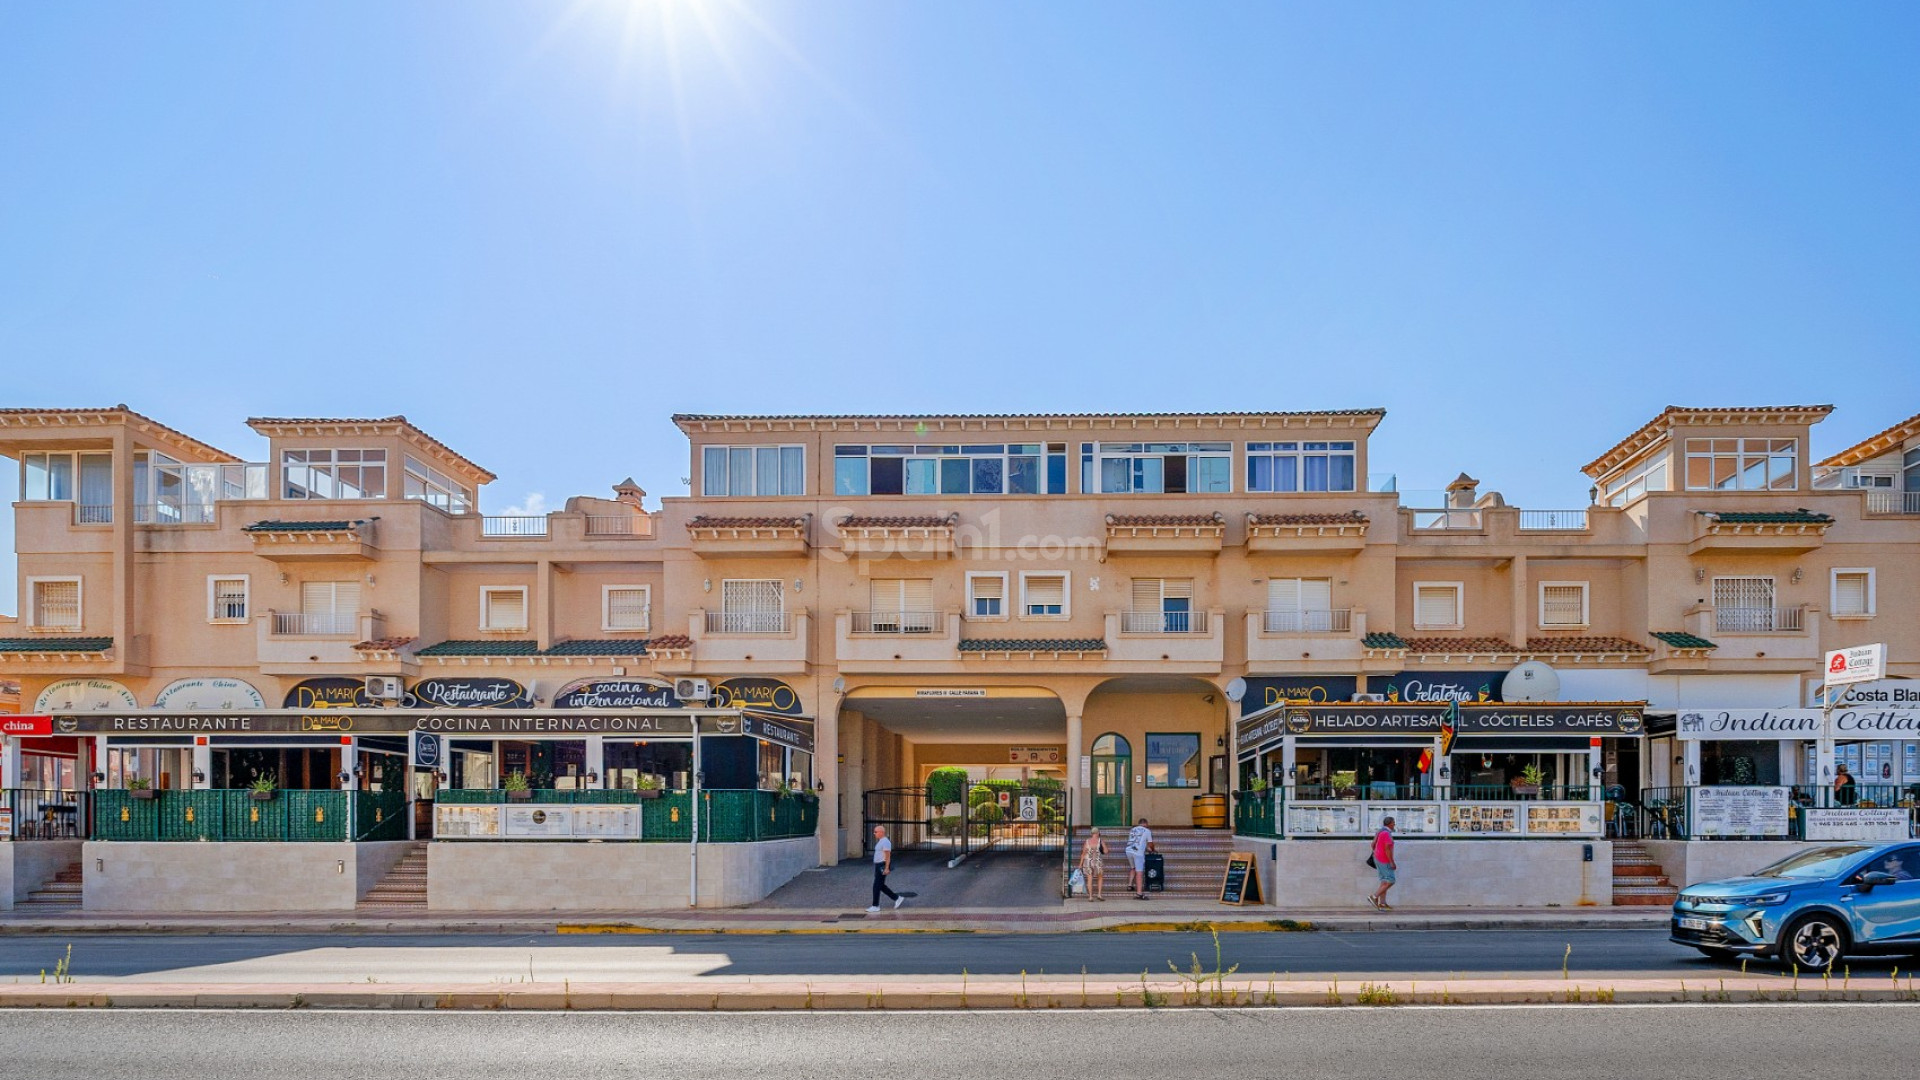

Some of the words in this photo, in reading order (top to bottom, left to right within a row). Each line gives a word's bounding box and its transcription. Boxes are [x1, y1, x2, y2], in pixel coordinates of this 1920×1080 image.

[87, 680, 112, 689] Chino
[596, 681, 643, 693] cocina
[1404, 680, 1472, 702] Gelatería
[427, 681, 510, 706] Restaurante
[569, 691, 670, 707] internacional
[716, 685, 741, 708] DA
[744, 685, 795, 710] MARIO
[1265, 687, 1285, 705] DA
[1287, 686, 1327, 702] MARIO
[1845, 689, 1888, 701] Costa
[3, 721, 34, 730] china
[115, 717, 251, 730] RESTAURANTE
[302, 716, 318, 731] DA
[416, 718, 491, 730] COCINA
[502, 718, 663, 730] INTERNACIONAL
[1315, 715, 1377, 727] HELADO
[1381, 715, 1468, 727] ARTESAL
[1479, 712, 1554, 727] CÓCTELES
[1565, 712, 1612, 727] CAFÉS
[1709, 711, 1820, 731] Indian
[763, 722, 799, 745] RESTAURANTE
